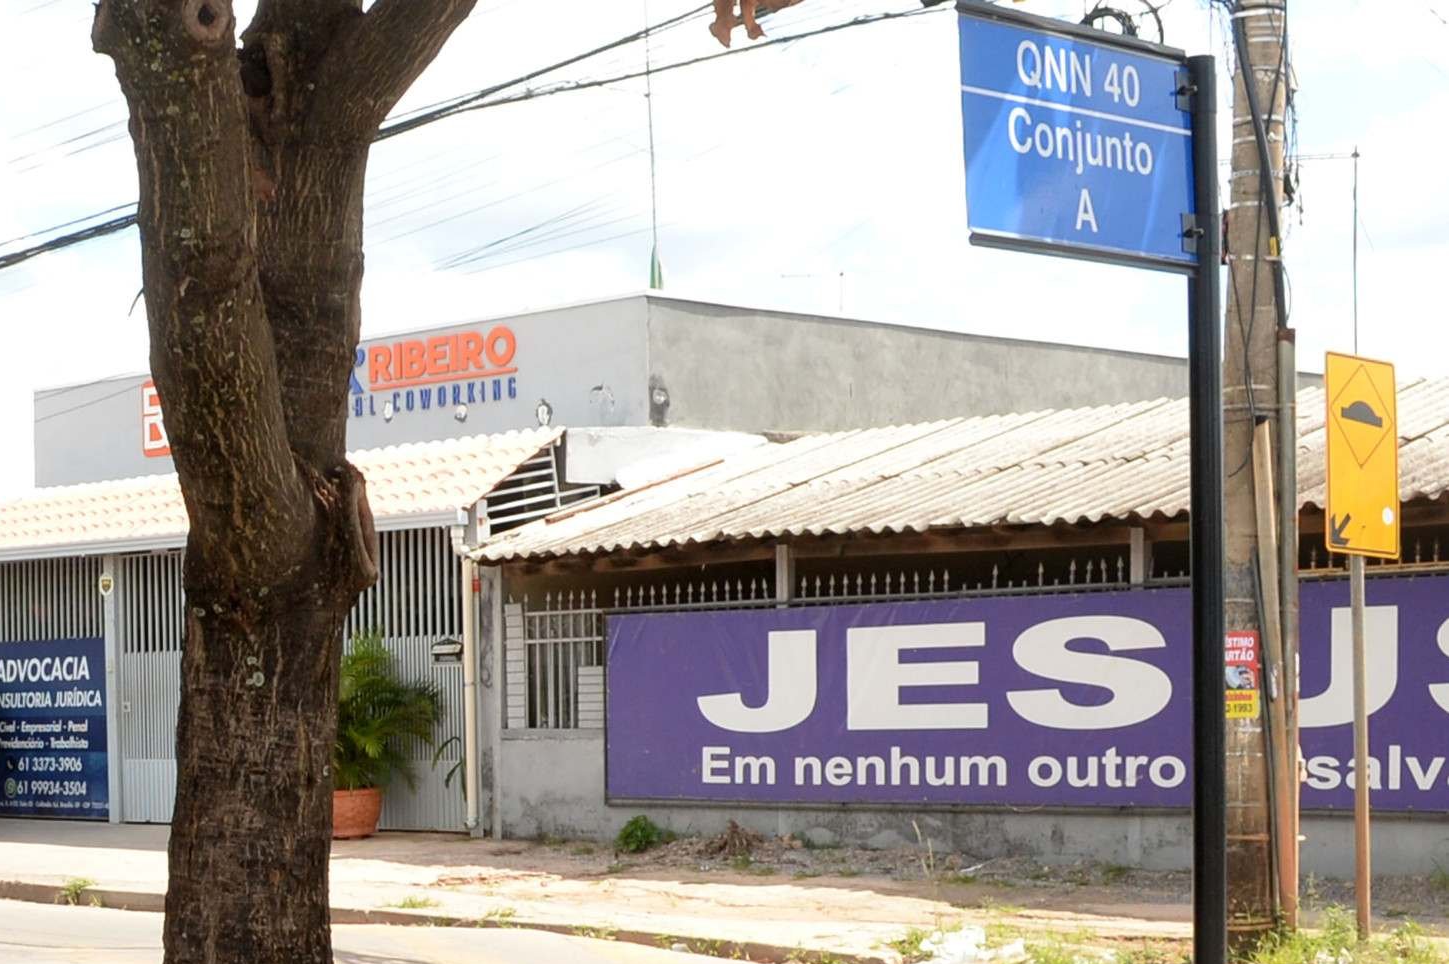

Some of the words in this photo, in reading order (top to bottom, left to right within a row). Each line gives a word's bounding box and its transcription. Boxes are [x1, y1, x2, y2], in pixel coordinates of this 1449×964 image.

[1016, 39, 1092, 97] QNN
[1103, 62, 1140, 108] 40
[1007, 106, 1154, 177] Conjunto
[1075, 187, 1099, 233] A
[368, 324, 518, 384] RIBEIRO
[392, 377, 518, 413] COWORKING
[54, 686, 102, 708] JURÍDICA
[18, 757, 29, 771] 61
[32, 757, 83, 772] 3373-3906
[701, 745, 777, 785] Em
[794, 745, 1008, 787] nenhum
[1027, 745, 1187, 788] outro
[1306, 744, 1449, 791] salv
[17, 781, 28, 795] 61
[31, 780, 87, 796] 99934-3504
